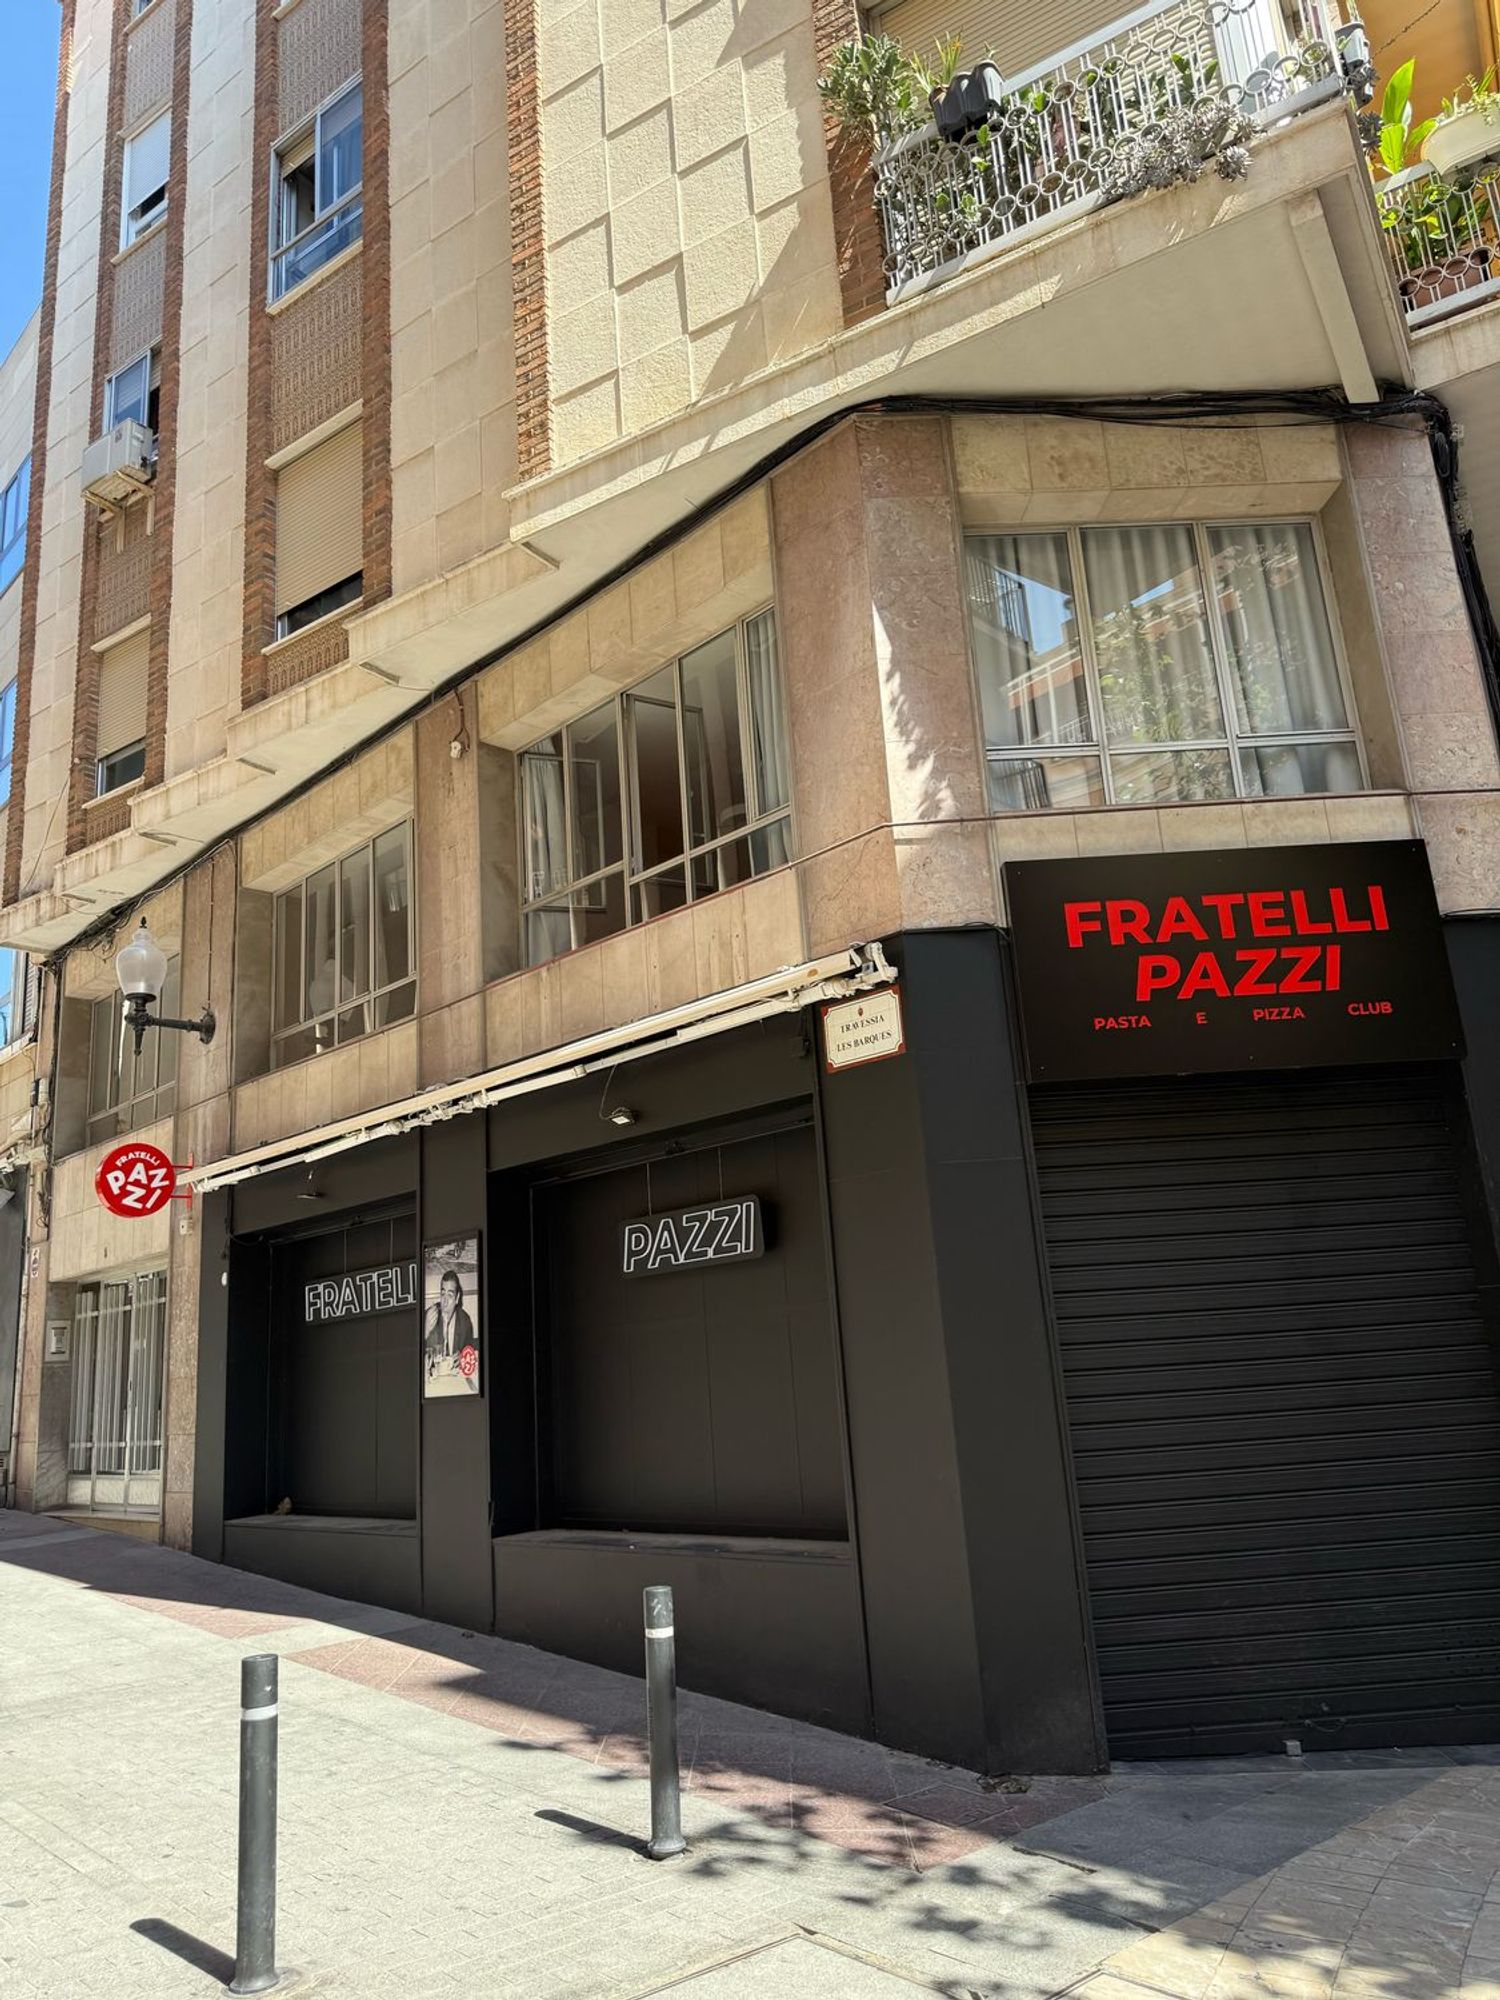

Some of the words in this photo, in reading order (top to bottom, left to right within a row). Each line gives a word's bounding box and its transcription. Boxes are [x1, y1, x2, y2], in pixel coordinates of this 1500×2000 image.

[1063, 885, 1390, 948] FRATELLI
[1136, 944, 1341, 1002] PAZZI
[836, 1042, 852, 1052] LES
[853, 1029, 893, 1048] BARQUES
[1093, 1015, 1152, 1031] PASTA
[1196, 1012, 1208, 1024] E
[1253, 1006, 1305, 1022] PIZZA
[1347, 1001, 1393, 1017] CLUB
[115, 1151, 161, 1167] FRATELLI
[623, 1201, 754, 1273] PAZZI
[305, 1263, 417, 1322] FRATEL
